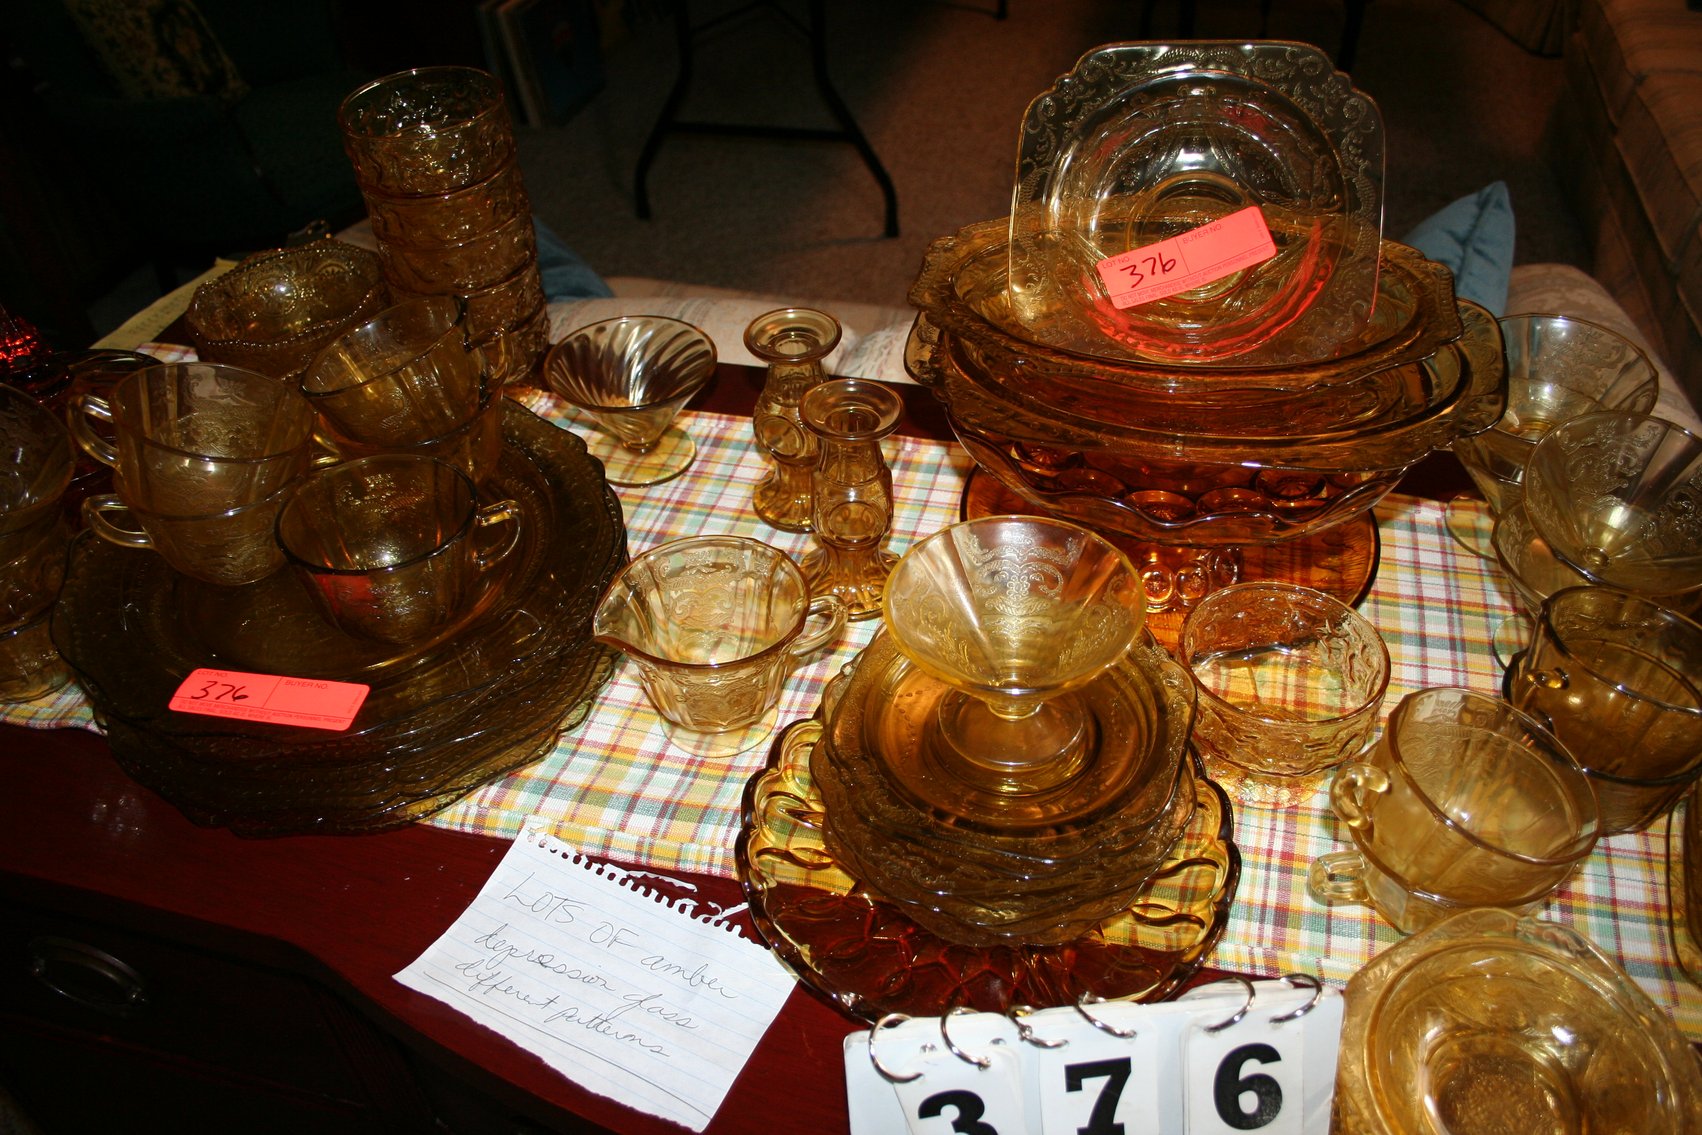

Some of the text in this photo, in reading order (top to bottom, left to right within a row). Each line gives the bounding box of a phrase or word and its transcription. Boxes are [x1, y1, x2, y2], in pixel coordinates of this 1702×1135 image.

[1119, 252, 1176, 289] 376
[191, 680, 249, 702] 376
[473, 922, 699, 1031] depression glass
[502, 871, 738, 1000] LOTS OF amber
[454, 958, 671, 1058] different patterns
